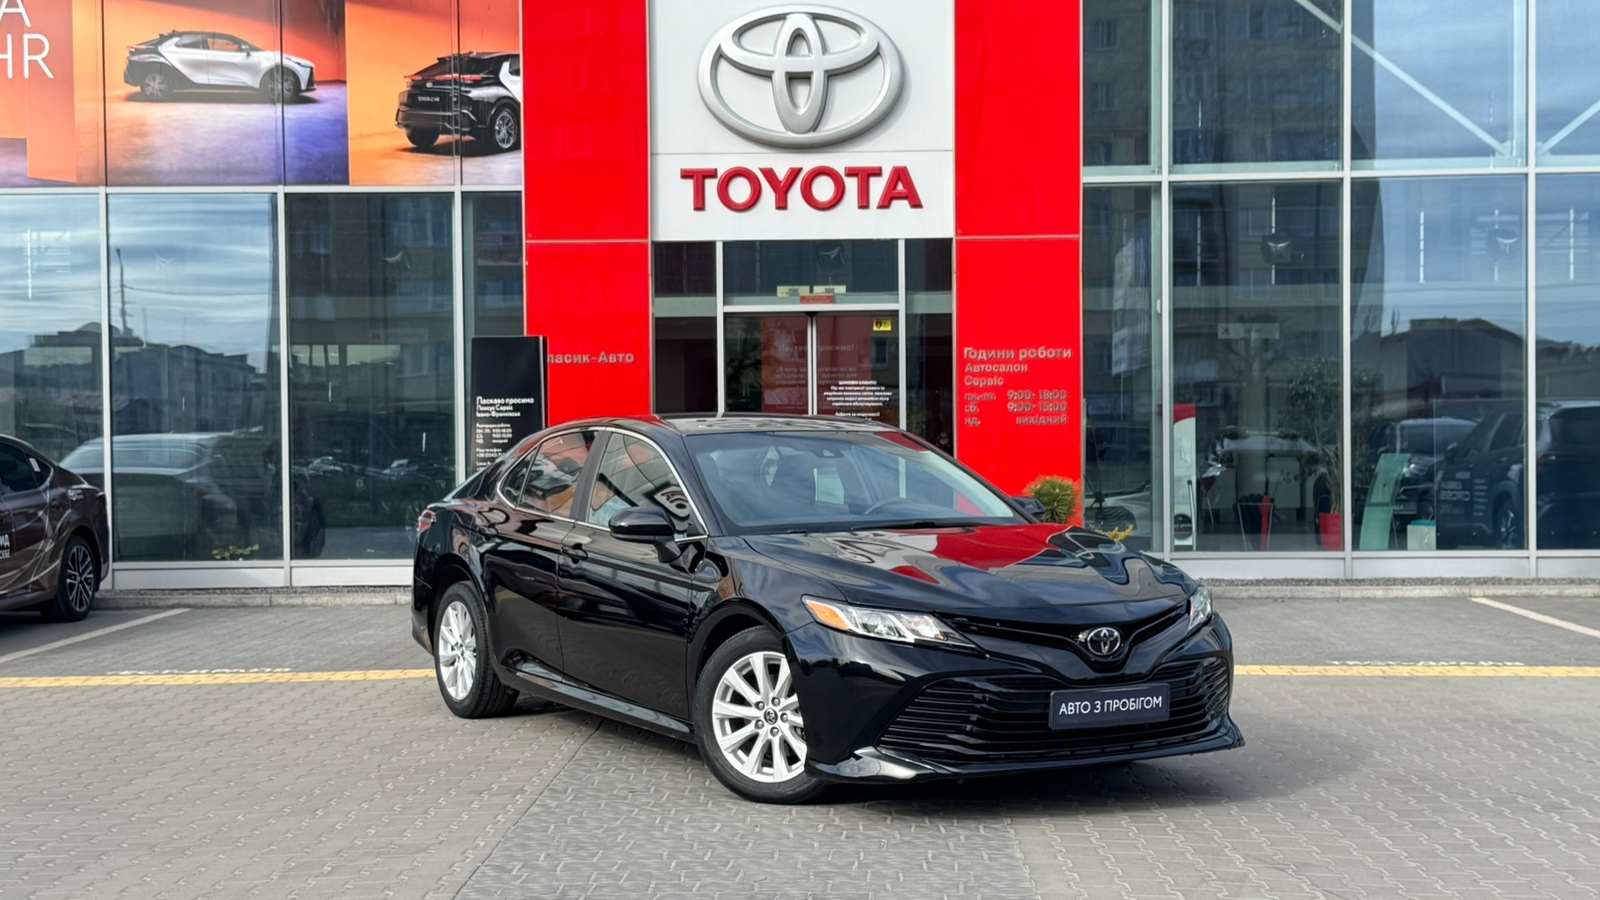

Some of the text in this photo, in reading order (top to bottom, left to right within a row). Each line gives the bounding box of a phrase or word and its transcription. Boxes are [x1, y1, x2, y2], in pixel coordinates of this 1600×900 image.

[680, 165, 924, 212] TOYOTA
[963, 346, 1073, 361] Години роботи
[965, 363, 1028, 373] Автосалон
[964, 375, 1004, 388] Сервіс
[1059, 701, 1091, 715] АВТО
[1104, 695, 1162, 712] ПРОБІГОМ
